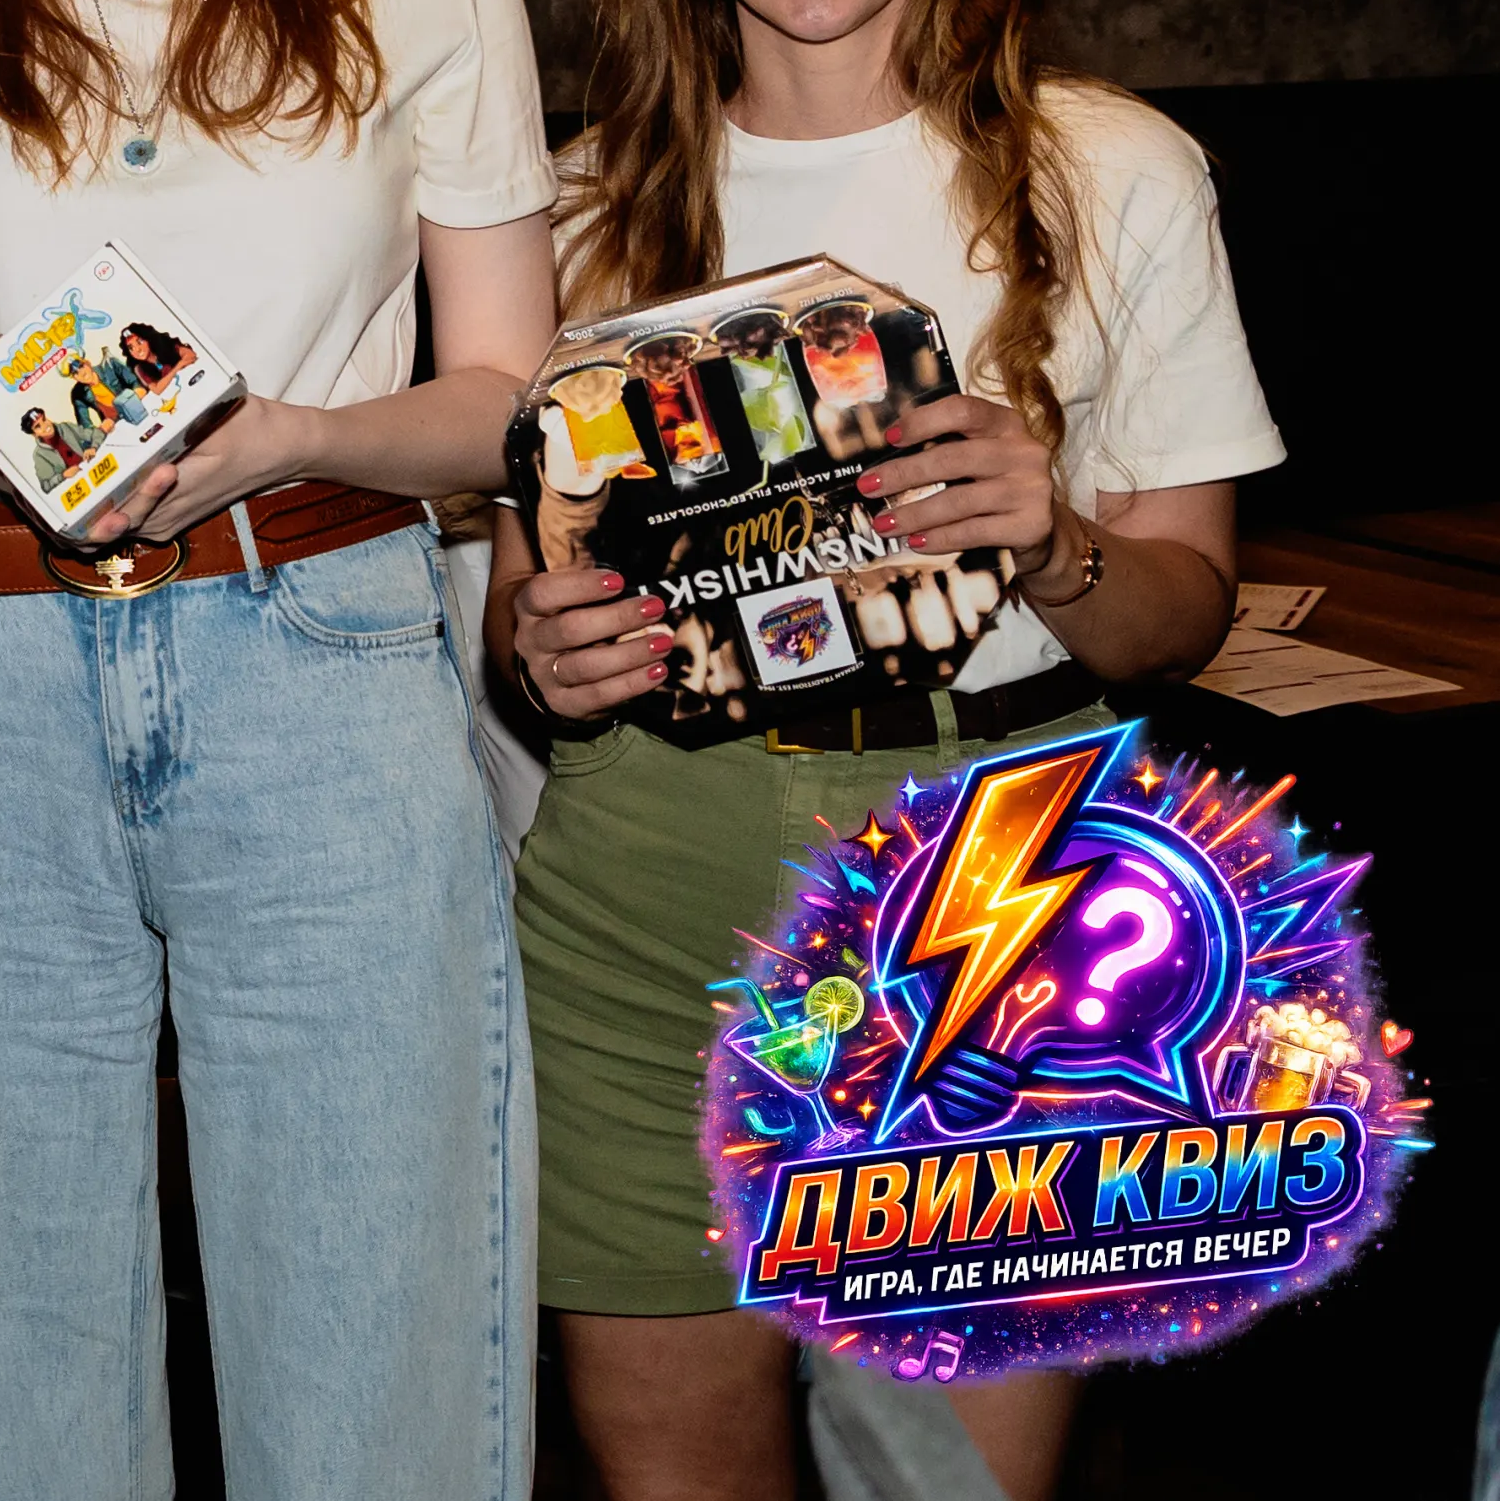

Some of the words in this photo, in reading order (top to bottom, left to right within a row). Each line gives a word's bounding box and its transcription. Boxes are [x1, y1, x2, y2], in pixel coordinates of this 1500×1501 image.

[627, 326, 652, 339] COLA
[0, 313, 76, 385] МИСТЕР
[93, 457, 110, 477] 100
[835, 464, 862, 478] FINE
[775, 471, 832, 492] ALCOHOL
[729, 487, 772, 504] FILLED
[647, 498, 728, 525] CHOCOLATES
[724, 496, 814, 567] Club
[638, 532, 900, 609] IN&WHISK
[791, 673, 834, 690] TRADITION
